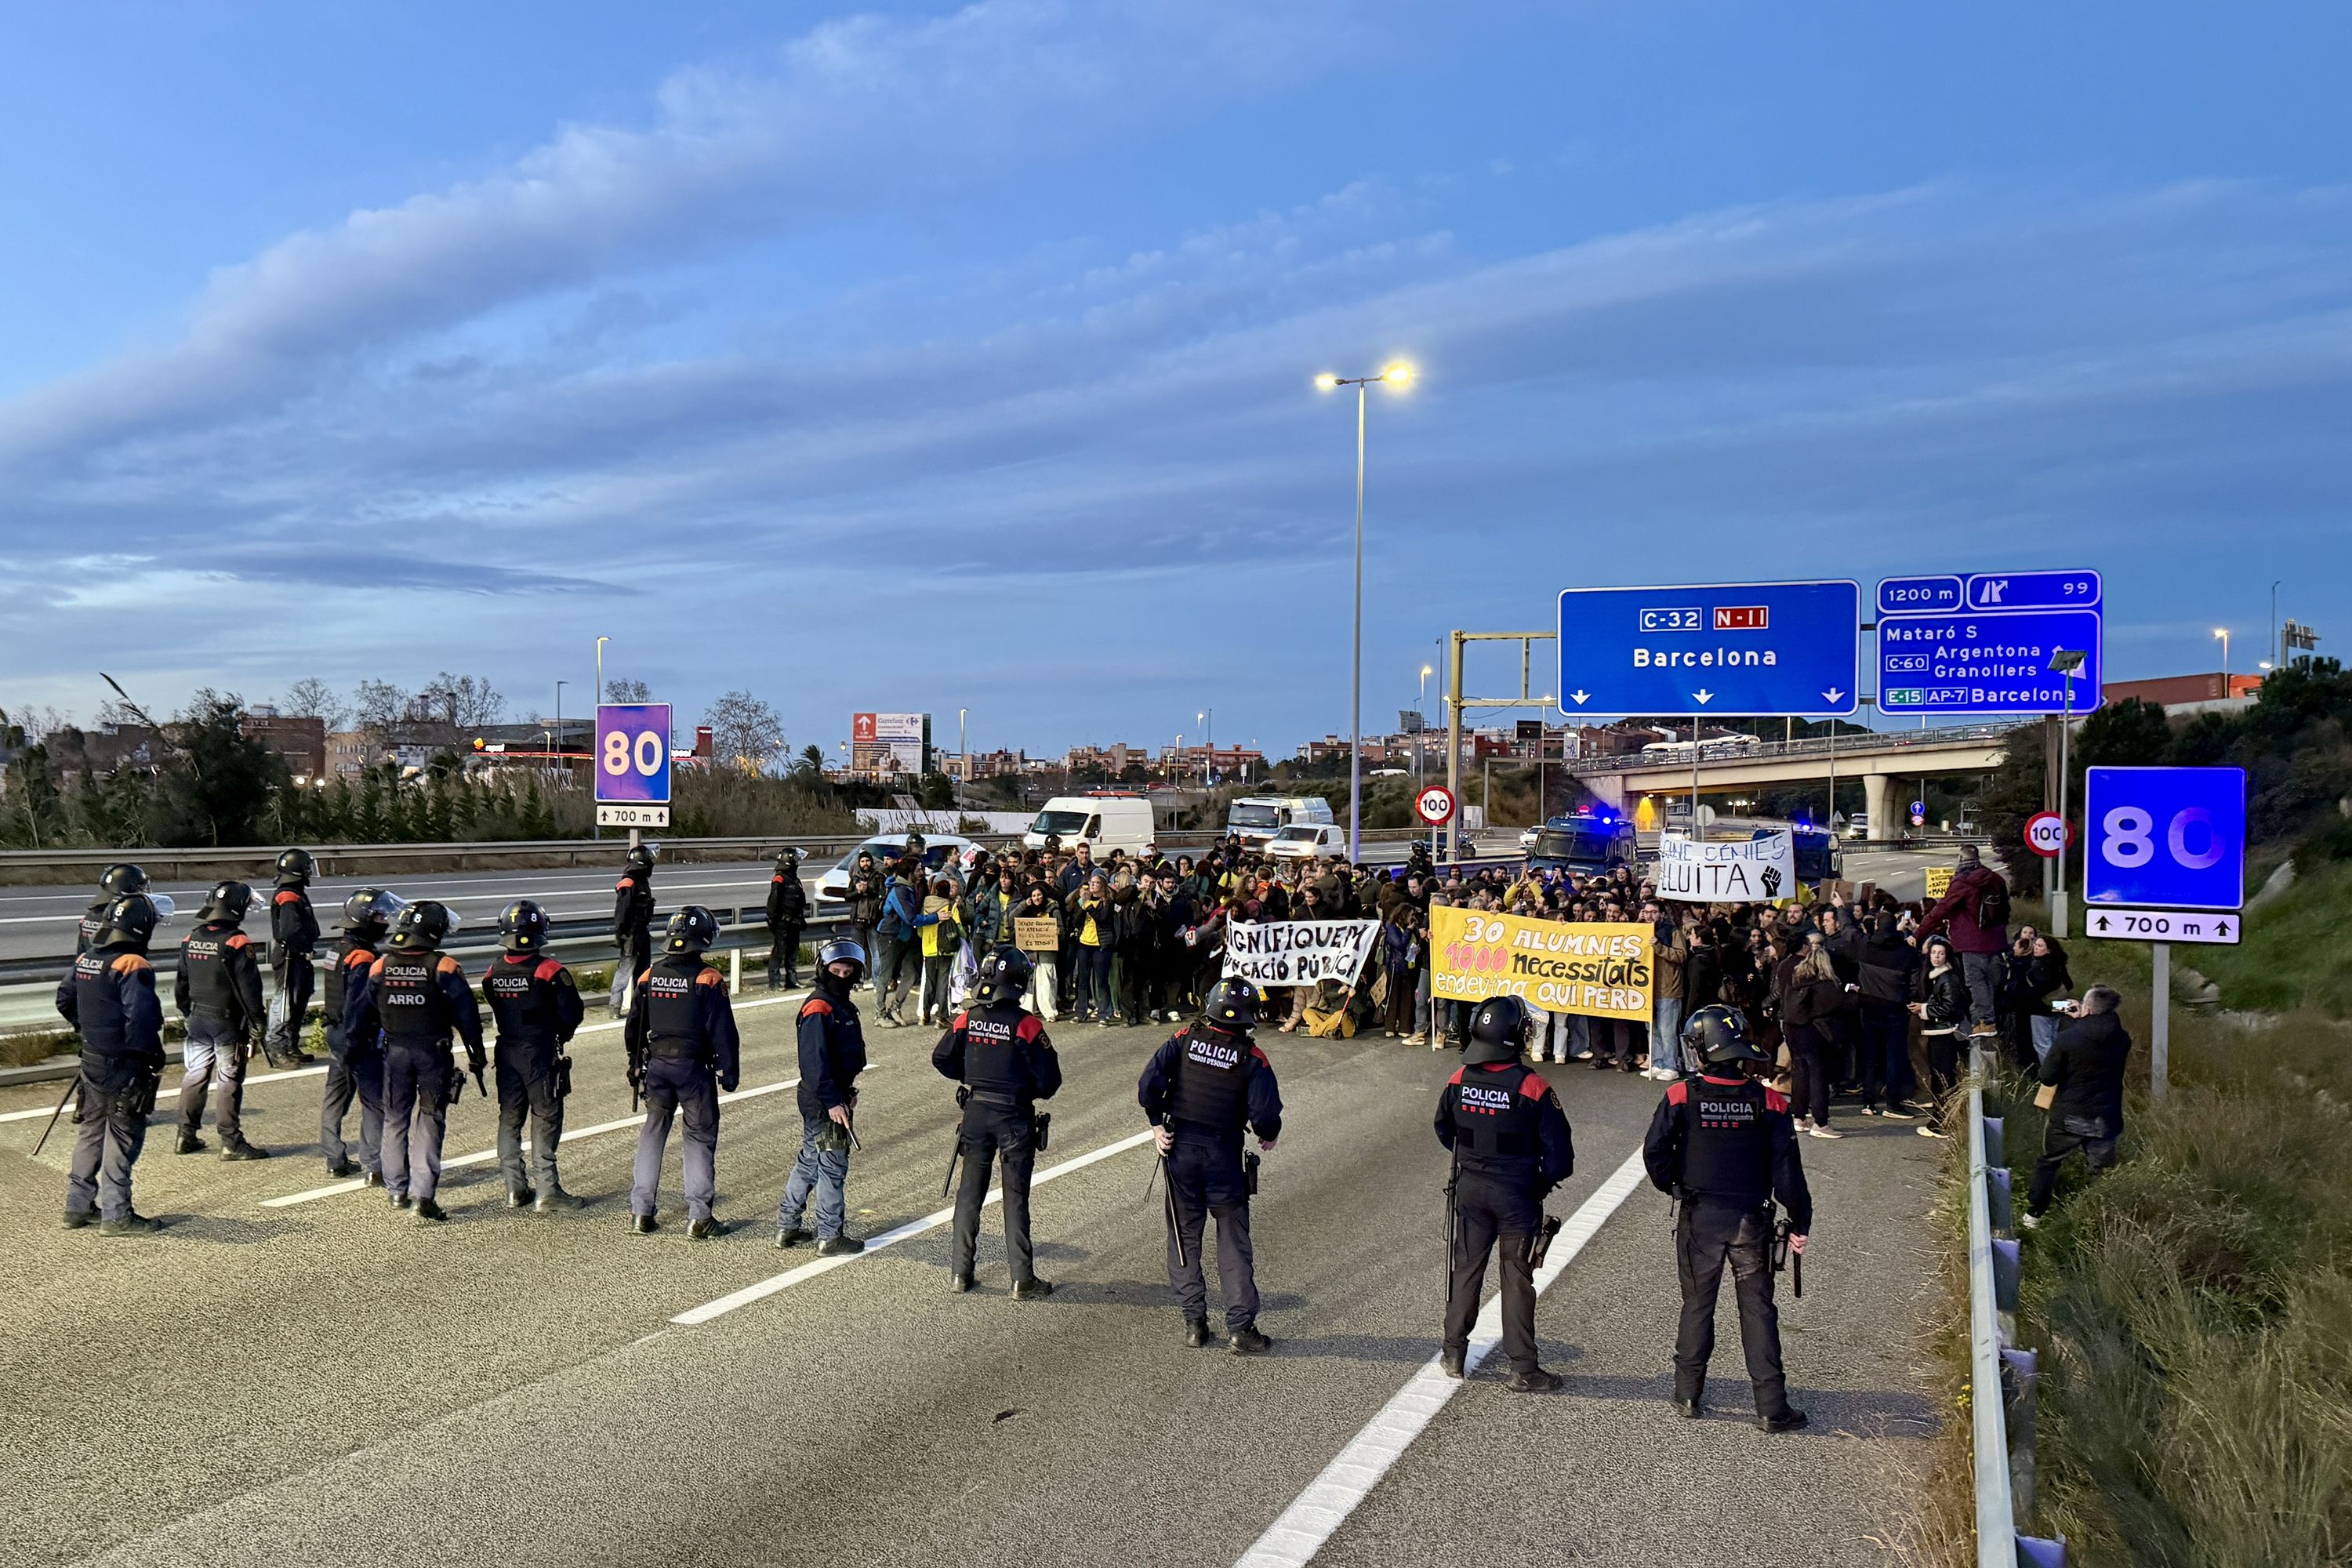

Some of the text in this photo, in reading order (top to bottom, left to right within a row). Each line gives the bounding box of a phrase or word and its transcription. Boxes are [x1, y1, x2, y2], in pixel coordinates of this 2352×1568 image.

[1889, 588, 1953, 601] 1200 m
[2063, 583, 2089, 595] 99
[1644, 612, 1698, 628] C-32
[1886, 625, 1978, 641] Mataró S
[1633, 647, 1777, 667] Barcelona
[1935, 644, 2041, 661] Argentona
[1889, 657, 1926, 670] C-60
[1934, 664, 2038, 678] Granollers
[1888, 689, 1921, 703] E-15
[1928, 689, 1965, 702] AP-7
[1971, 687, 2076, 702] Barcelona
[604, 730, 663, 777] 80
[1423, 799, 1448, 811] 100
[615, 811, 652, 822] 700 m
[2102, 805, 2227, 869] 80
[413, 913, 423, 924] 8
[531, 913, 538, 922] 8
[689, 916, 697, 926] 8
[1463, 916, 1506, 944] 30
[2125, 916, 2201, 935] 700 m
[1512, 928, 1643, 958] ALUMNES
[385, 966, 428, 976] POLICIA
[998, 960, 1007, 971] 8
[1443, 941, 1650, 988] 1000 necessitats
[493, 977, 529, 987] POLICIA
[652, 976, 688, 989] POLICIA
[1219, 982, 1229, 993] T
[1242, 986, 1250, 997] 8
[387, 993, 426, 1005] ARRO
[1483, 1012, 1492, 1025] 8
[1722, 1016, 1735, 1029] T
[968, 1019, 1011, 1036] POLICIA
[1189, 1039, 1239, 1064] POLICIA
[1461, 1086, 1511, 1104] POLICIA
[1700, 1102, 1754, 1113] POLICIA
